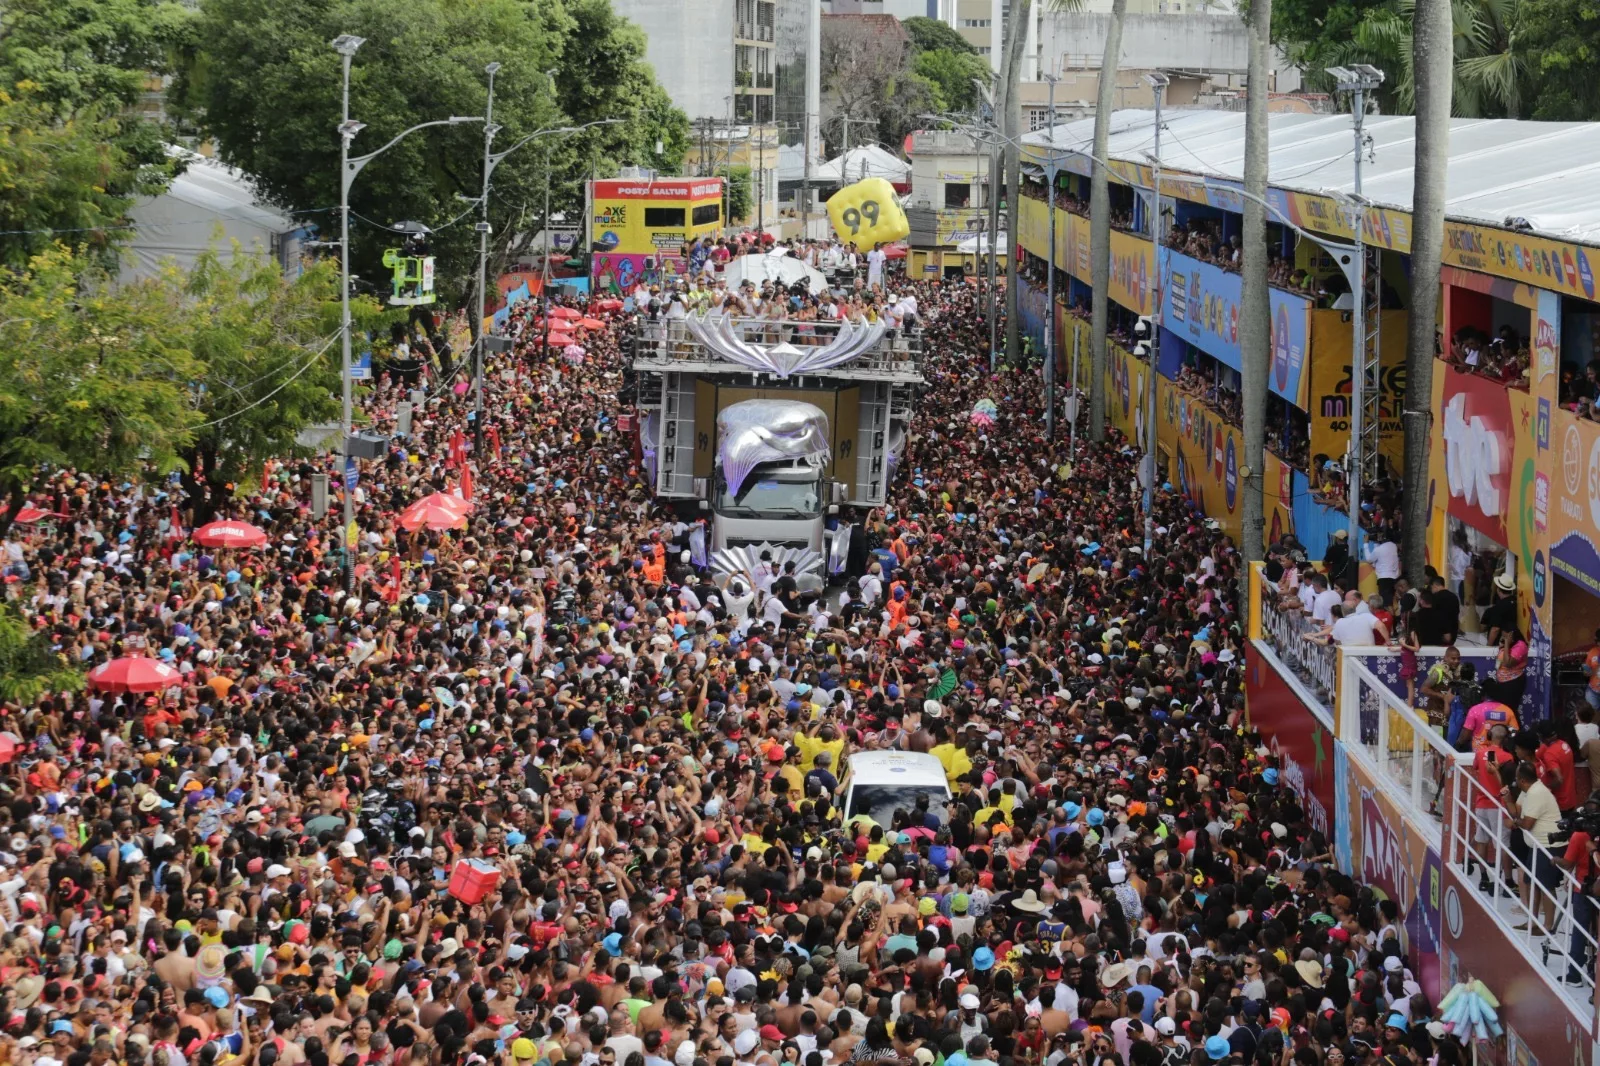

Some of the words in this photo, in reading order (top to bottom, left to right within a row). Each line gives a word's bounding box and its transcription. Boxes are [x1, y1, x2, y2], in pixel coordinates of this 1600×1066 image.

[618, 187, 649, 196] POSTO
[652, 188, 688, 196] SALTUR
[842, 200, 880, 236] 99
[1329, 421, 1348, 432] 40
[208, 526, 245, 537] BRAHMA
